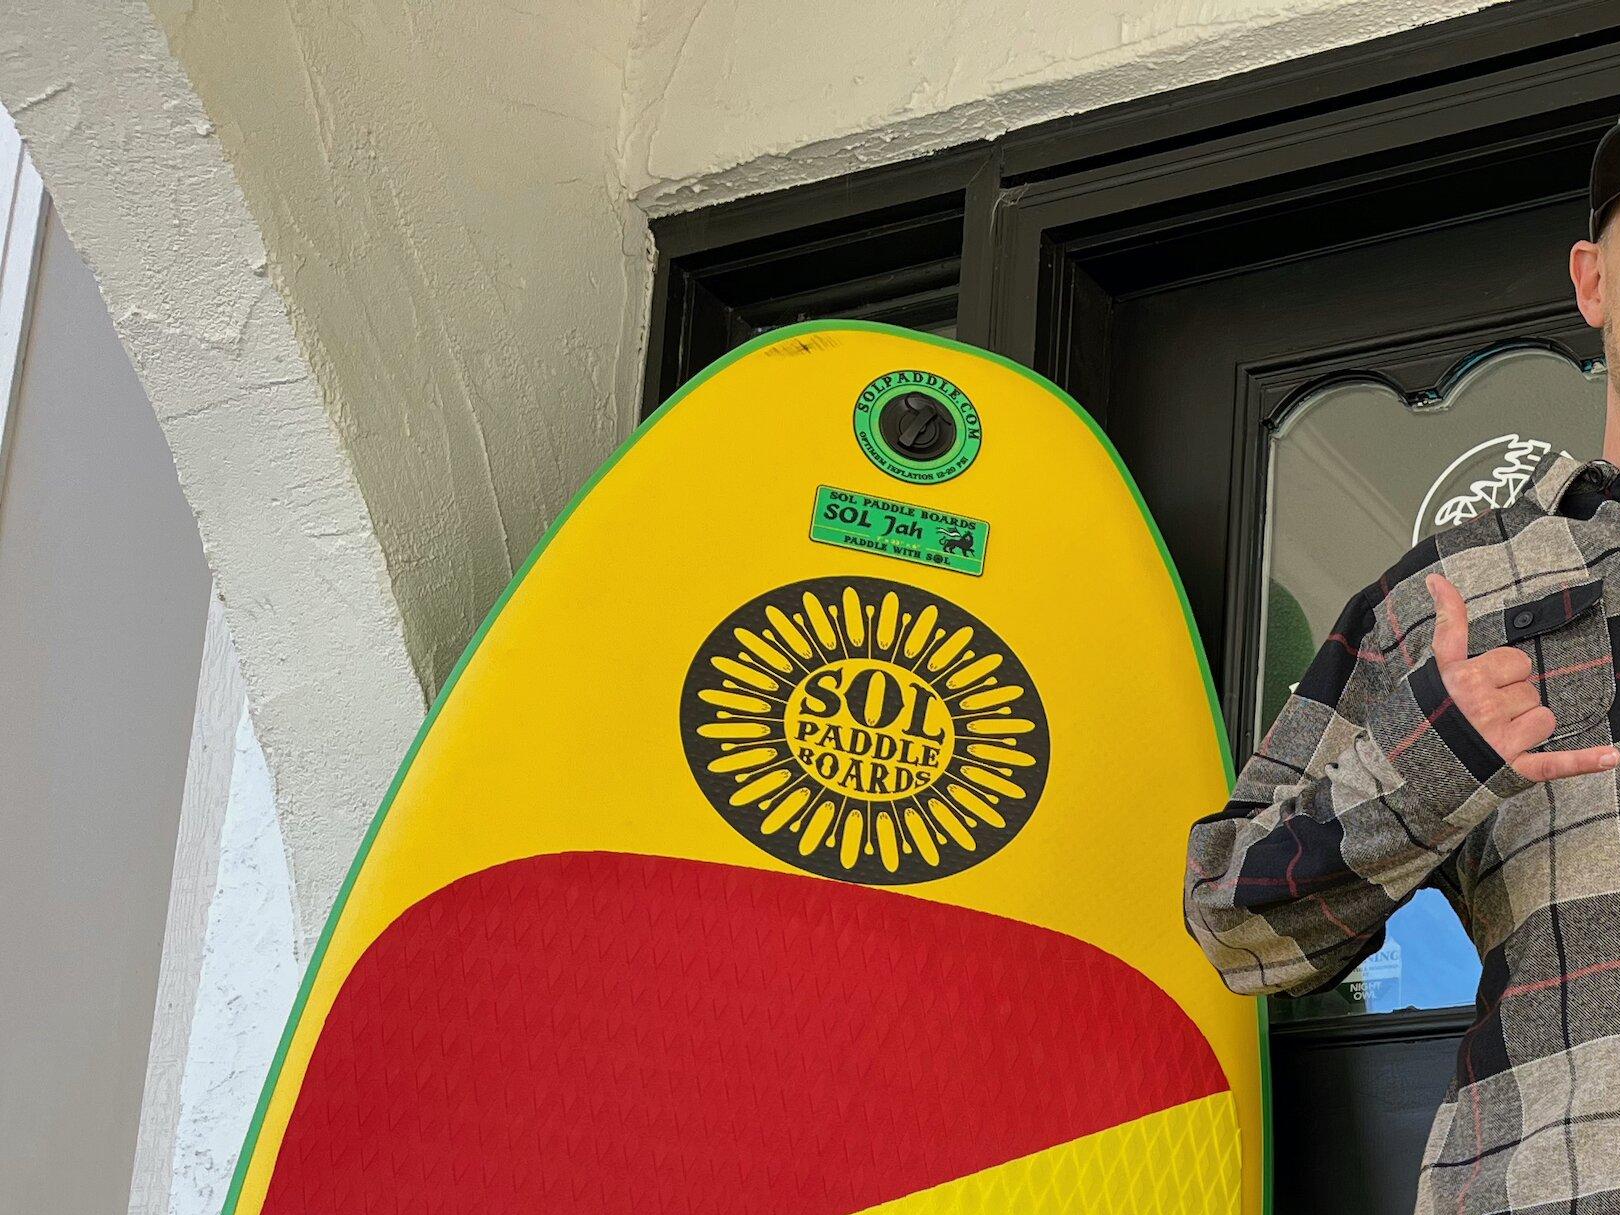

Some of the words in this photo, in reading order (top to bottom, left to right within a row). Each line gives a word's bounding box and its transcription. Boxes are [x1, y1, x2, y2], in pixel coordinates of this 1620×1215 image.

[857, 371, 981, 440] SOLPADDLE.COM
[859, 431, 887, 466] OPTIMUM
[887, 464, 934, 480] INFLATION
[823, 503, 872, 528] SOL
[880, 515, 923, 540] Jah
[829, 491, 857, 505] SOL
[863, 498, 915, 518] PADDLE
[921, 510, 976, 531] BOARDS
[844, 535, 887, 552] PADDLE
[893, 545, 921, 560] WITH
[798, 667, 946, 746] SOL
[795, 720, 941, 768] PADDLE
[797, 746, 932, 794] BOARDS
[1349, 982, 1382, 993] NIGHT
[1353, 991, 1377, 1001] OWL
